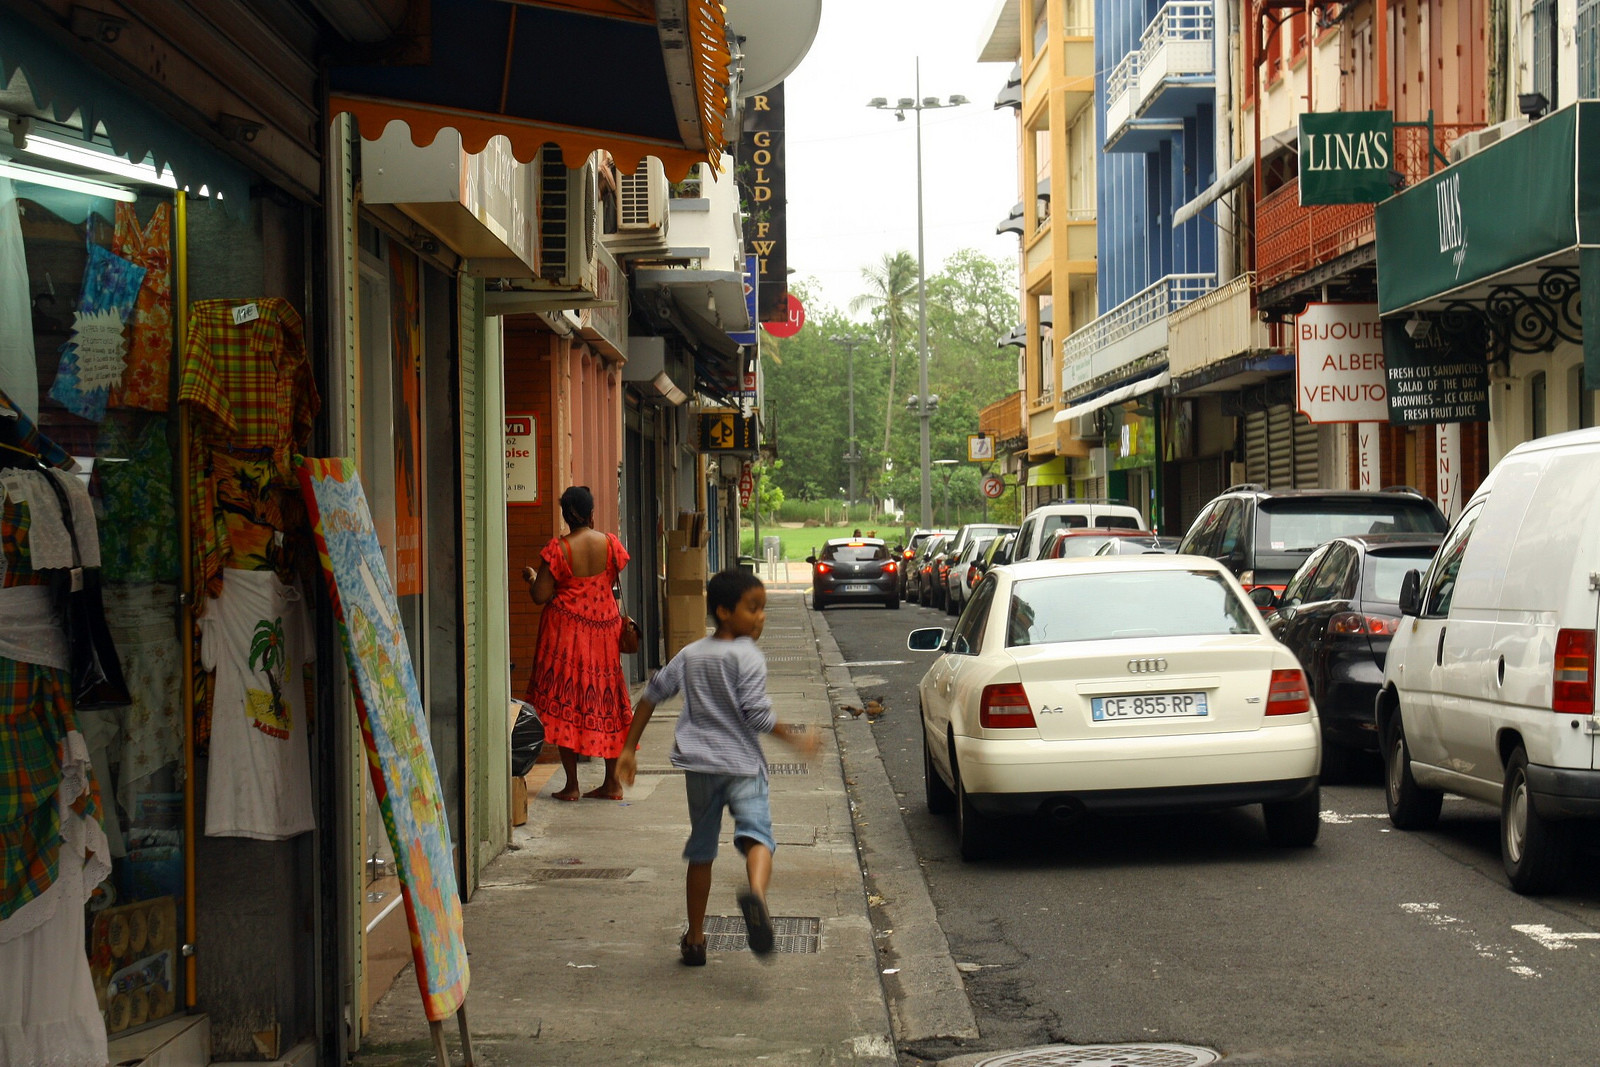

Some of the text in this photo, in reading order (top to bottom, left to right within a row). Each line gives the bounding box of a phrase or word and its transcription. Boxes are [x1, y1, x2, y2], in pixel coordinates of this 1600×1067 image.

[1307, 130, 1388, 171] LINA'S
[753, 131, 772, 202] GOLD
[1436, 172, 1462, 253] LINA'S
[752, 223, 776, 274] FWI
[1388, 363, 1484, 379] FRESH CUT SANDWICHES
[1398, 377, 1477, 393] SALAD OF THE DAY
[1392, 394, 1433, 408] BROWNIES
[1445, 392, 1456, 404] ICE
[1459, 391, 1485, 403] CREAM
[1404, 404, 1476, 420] FRESH FRUIT JUICE
[1039, 703, 1064, 714] A4
